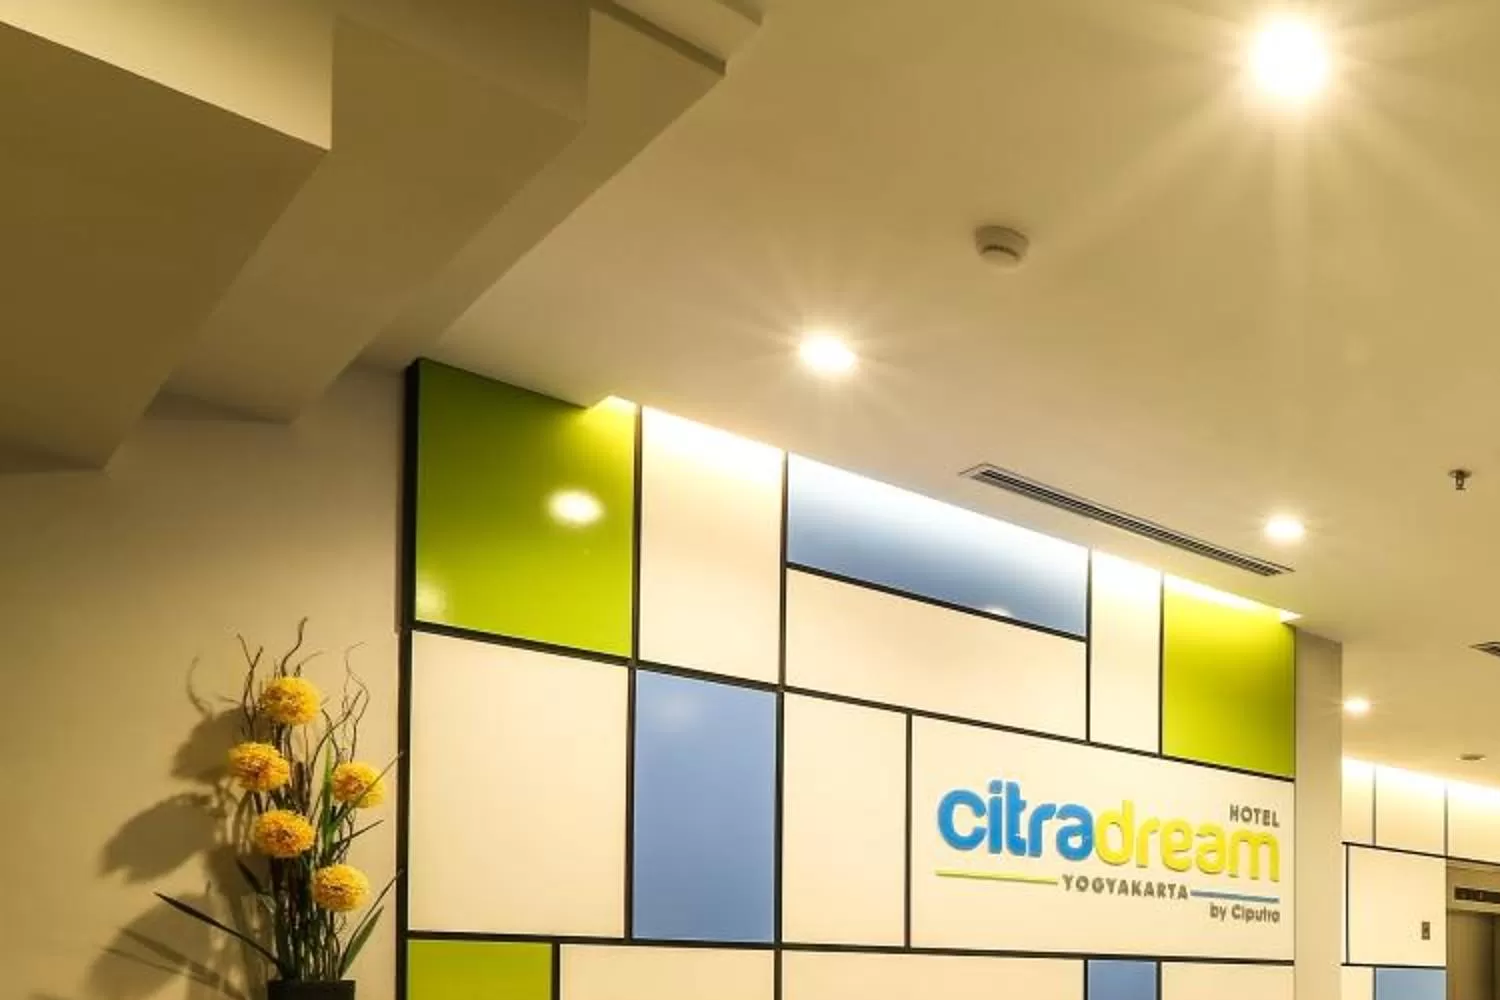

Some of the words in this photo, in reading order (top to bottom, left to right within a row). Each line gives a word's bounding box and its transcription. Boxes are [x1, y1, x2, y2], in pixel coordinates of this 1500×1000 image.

[1229, 803, 1280, 828] HOTEL
[1062, 874, 1189, 900] YOGYAKARTA
[1209, 902, 1227, 922] by
[1231, 904, 1280, 924] Ciputra
